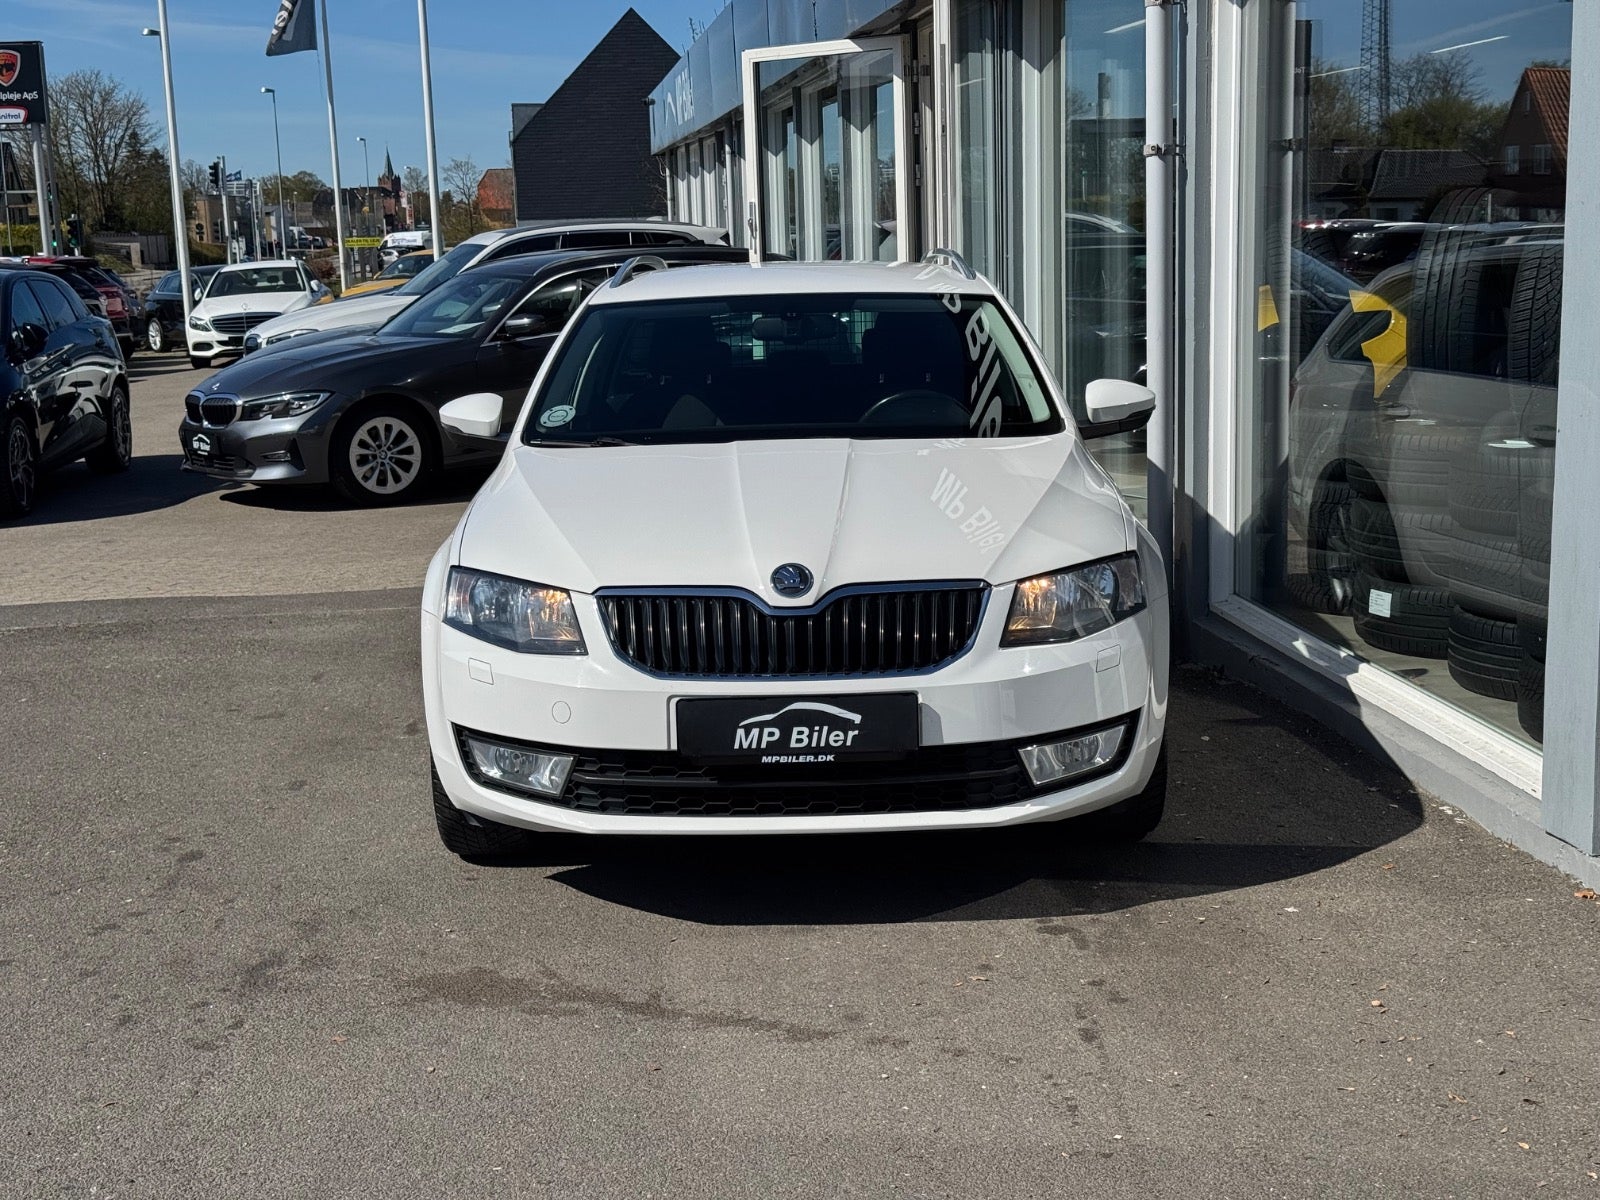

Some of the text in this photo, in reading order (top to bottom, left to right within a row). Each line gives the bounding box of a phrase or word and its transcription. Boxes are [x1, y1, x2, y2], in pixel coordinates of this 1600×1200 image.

[22, 91, 39, 101] ApS
[733, 725, 859, 750] MP Biler
[761, 754, 835, 763] MPBILER.DK
